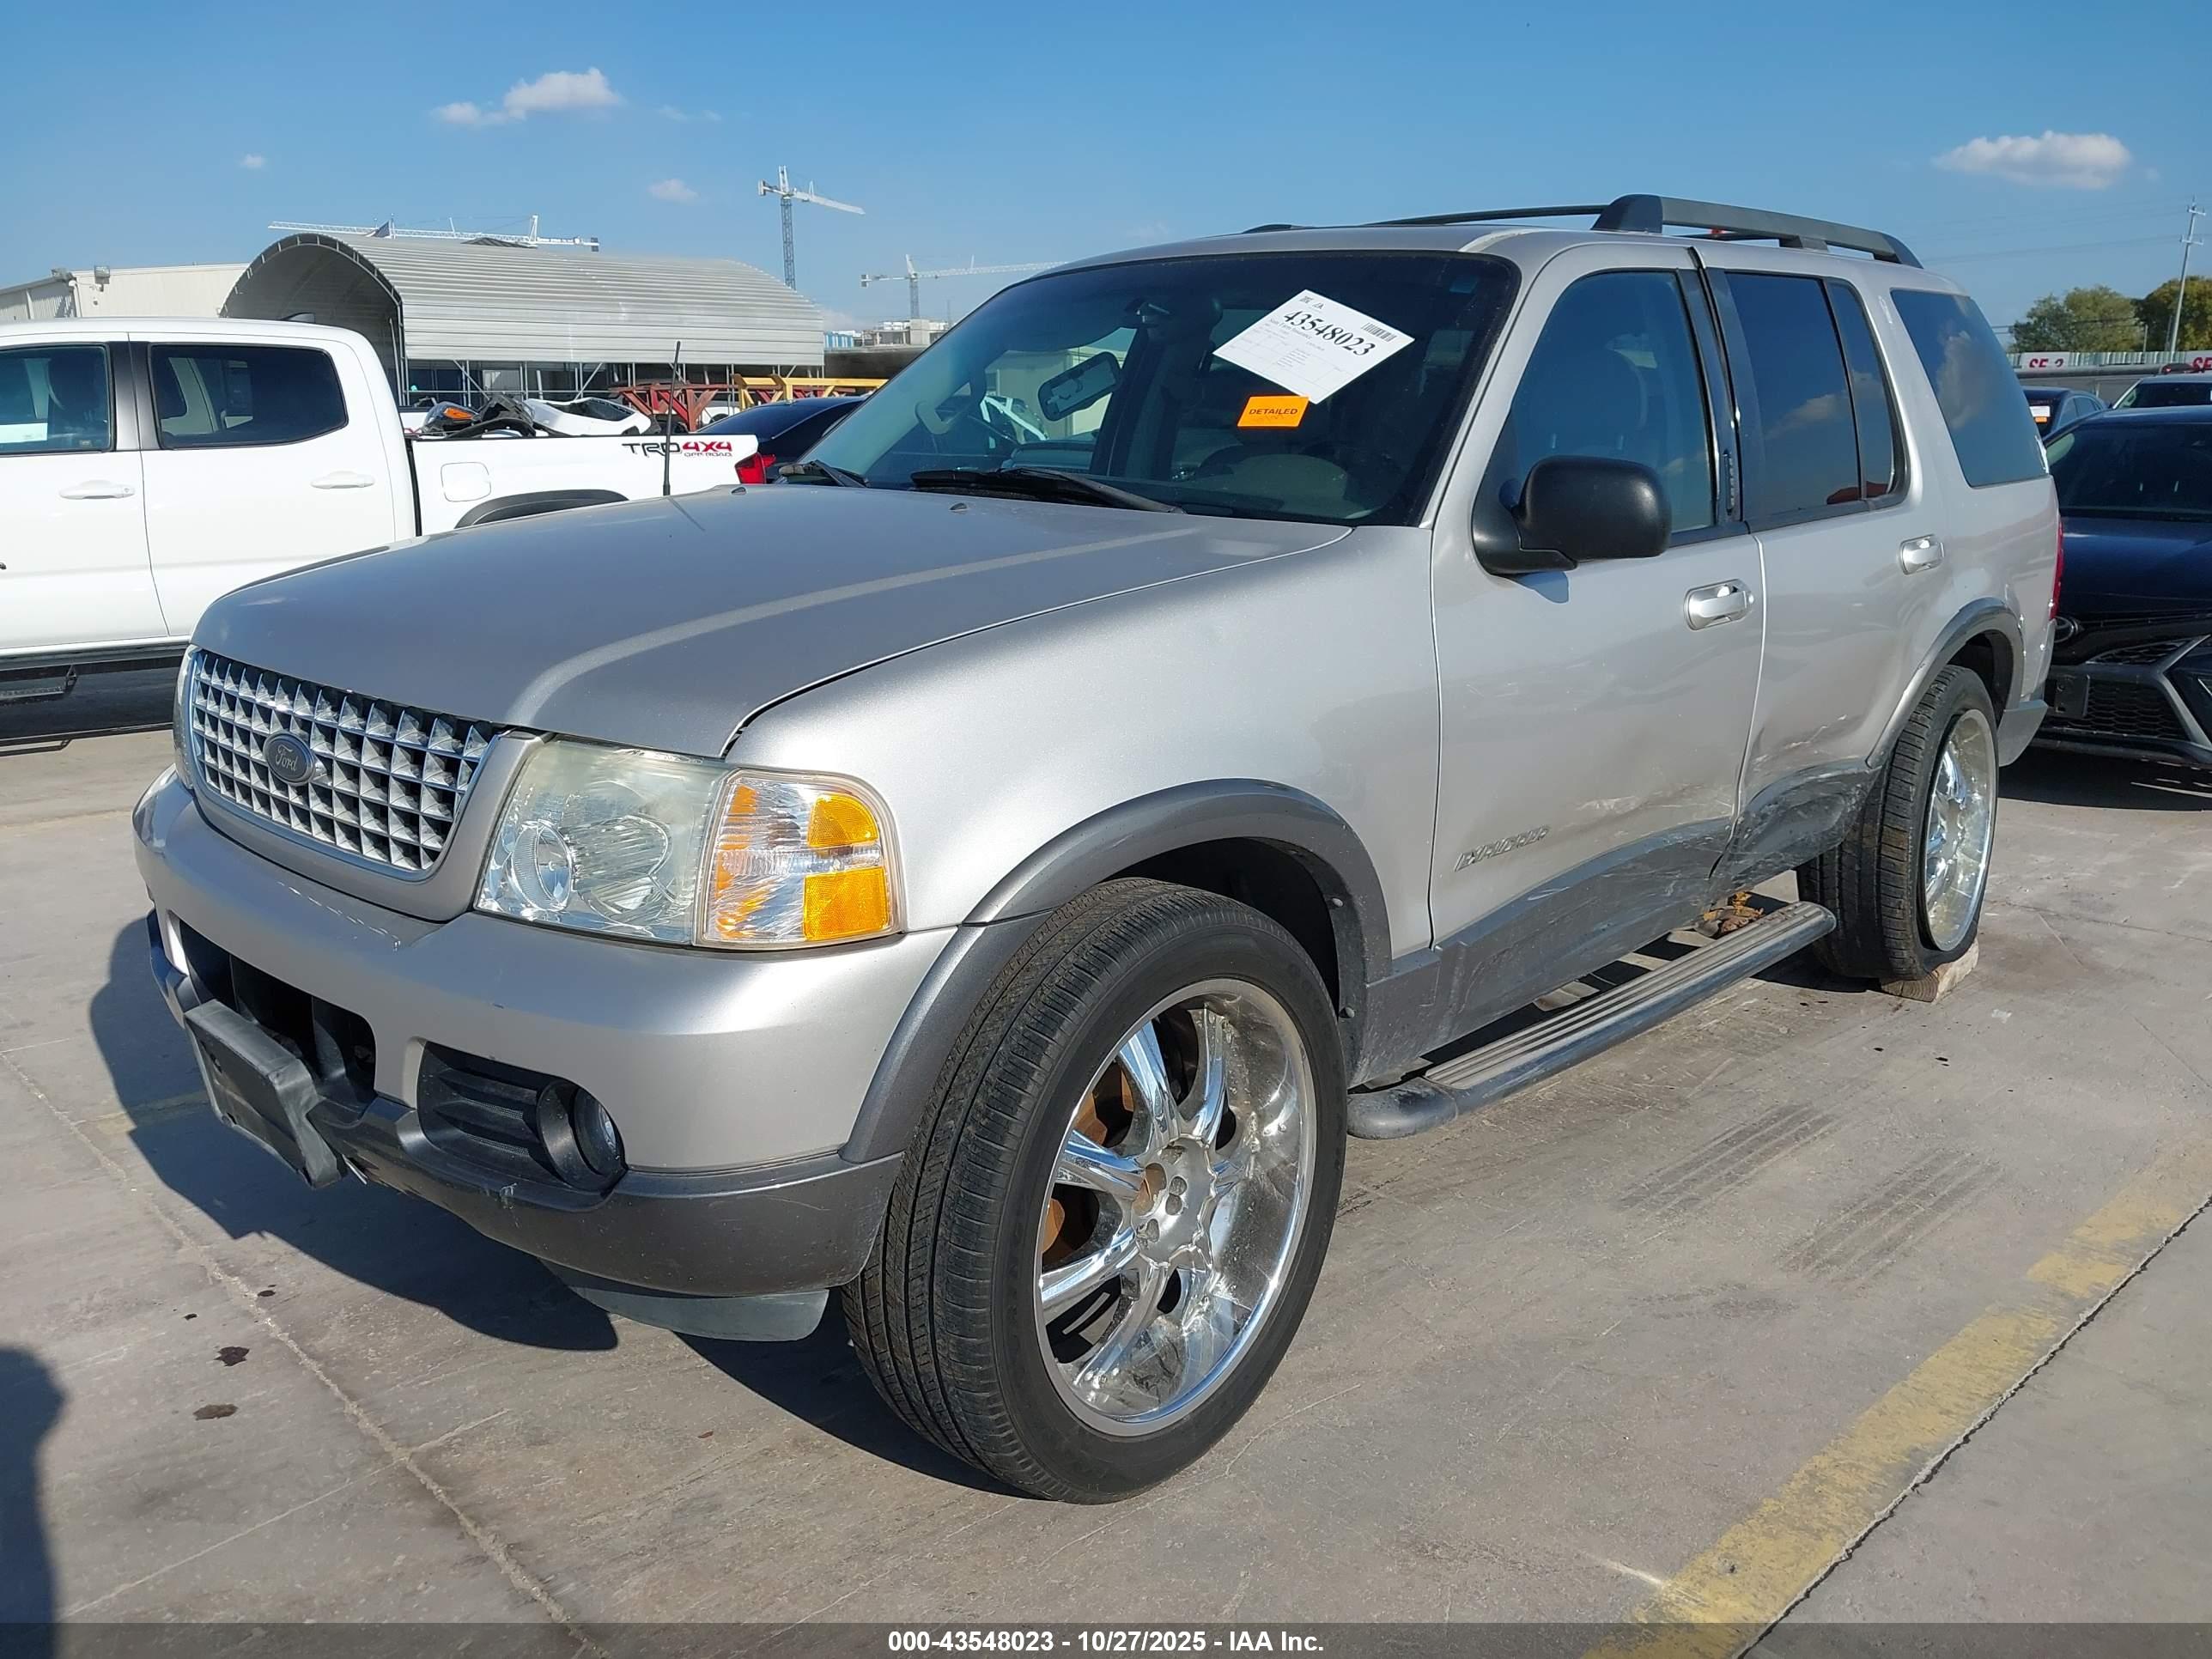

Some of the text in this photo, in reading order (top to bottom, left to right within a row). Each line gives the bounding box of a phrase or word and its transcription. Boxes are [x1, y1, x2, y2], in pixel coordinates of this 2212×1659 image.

[1284, 311, 1376, 357] 43548023
[622, 442, 682, 458] TRD
[275, 744, 299, 772] Ford
